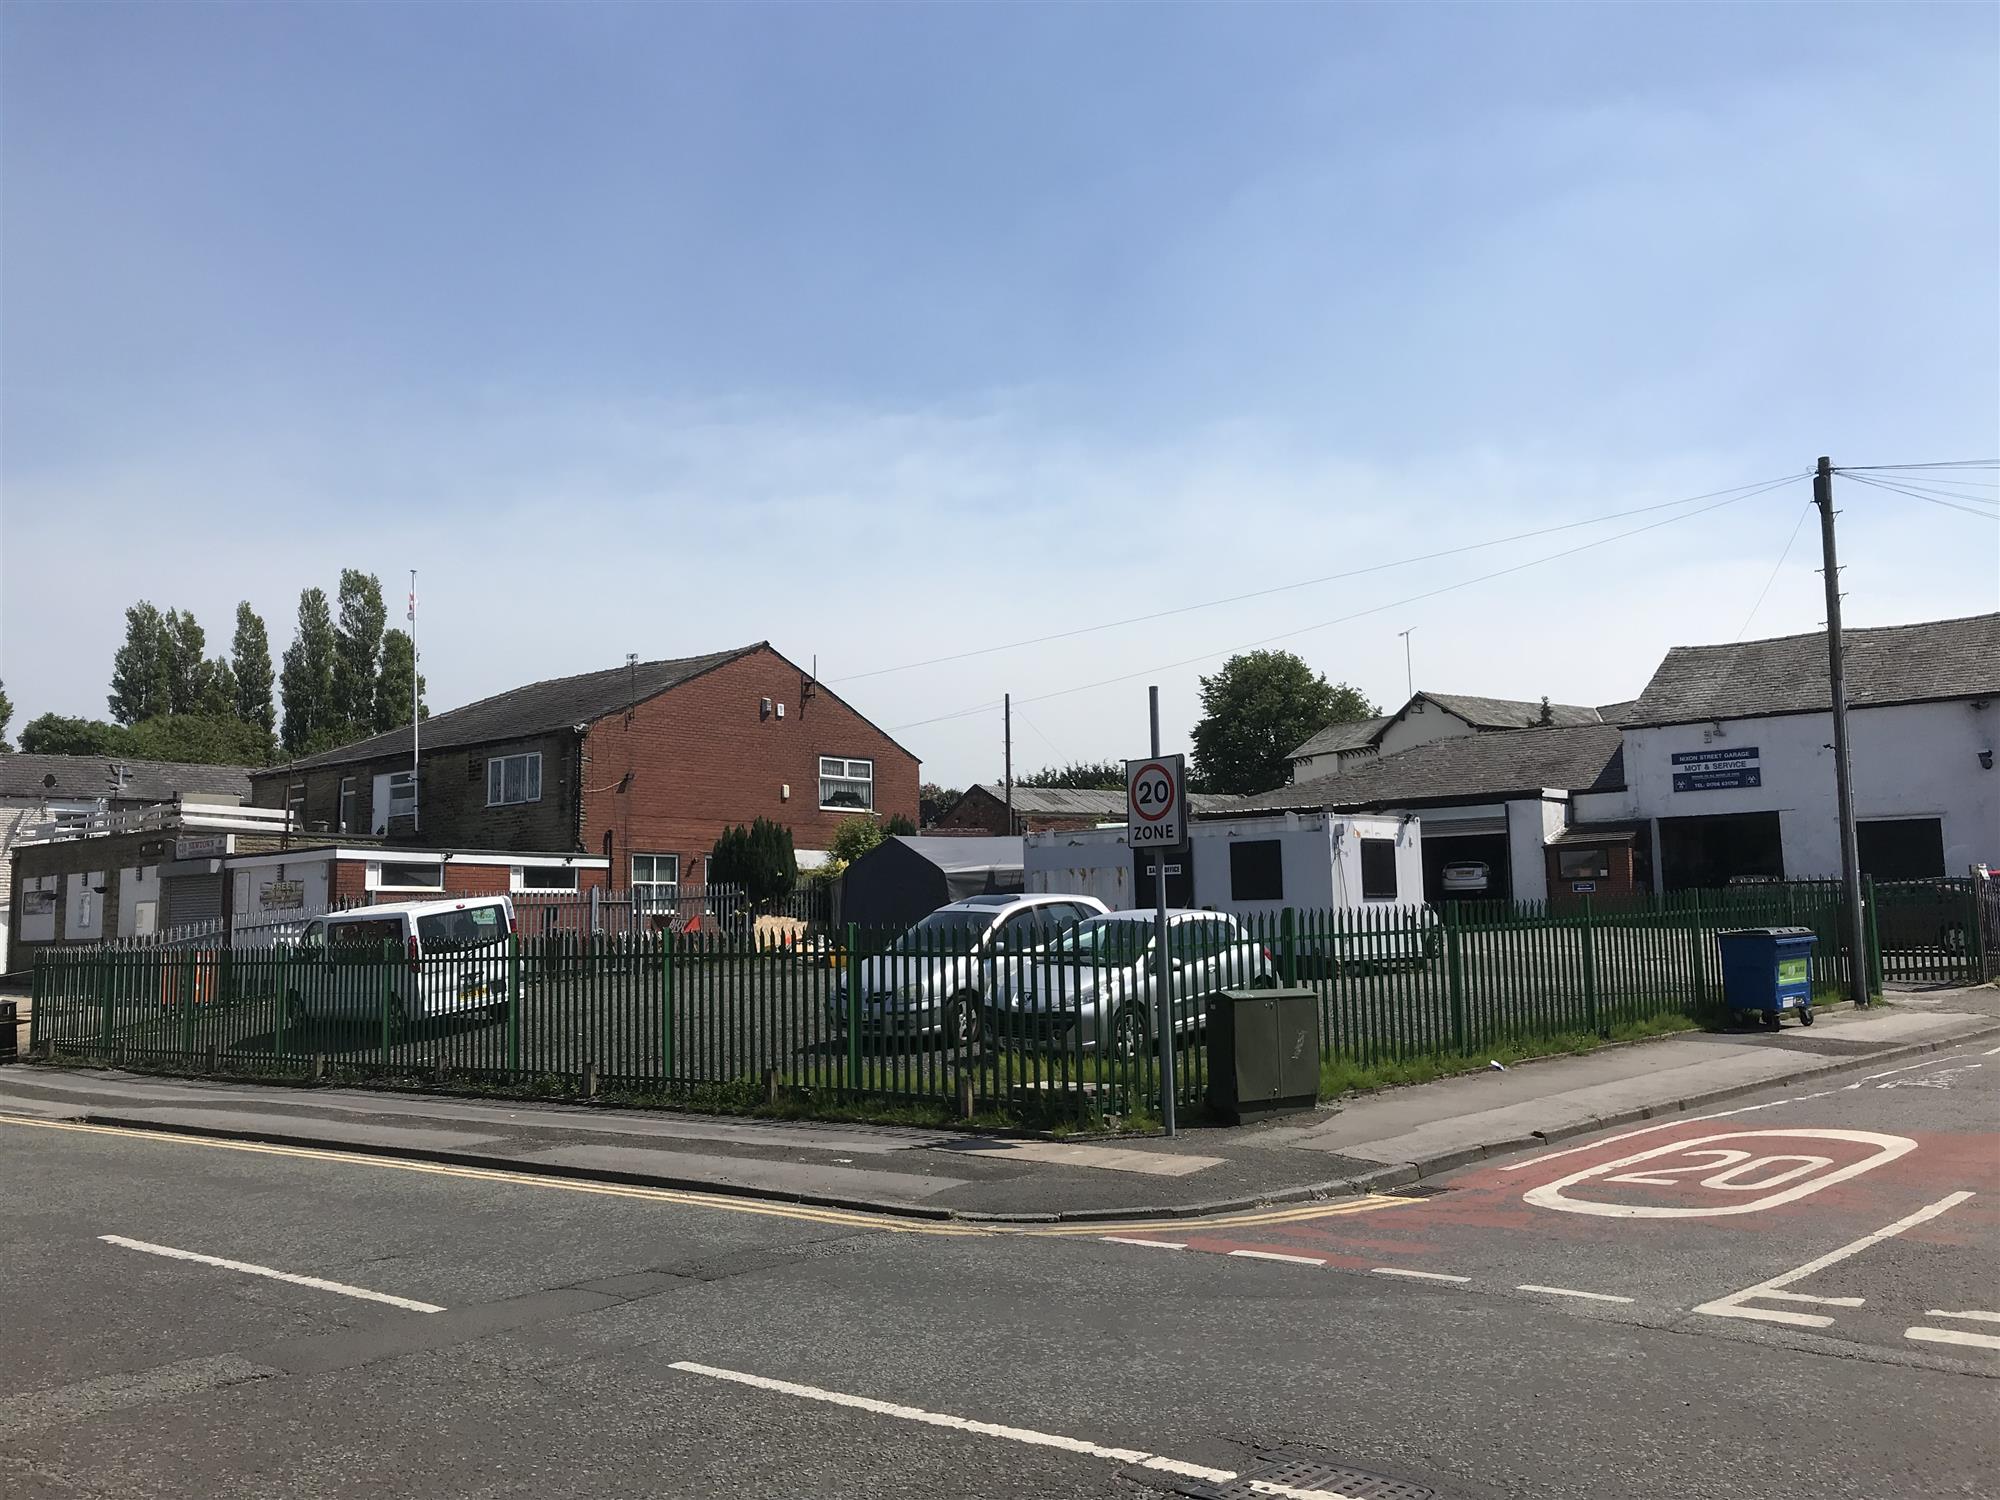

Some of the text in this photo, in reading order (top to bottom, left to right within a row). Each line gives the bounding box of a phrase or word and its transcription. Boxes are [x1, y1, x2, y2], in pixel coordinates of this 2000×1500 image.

[1684, 764, 1702, 772] MOT
[1712, 760, 1747, 770] SERVICE
[1138, 780, 1169, 804] 20
[1134, 824, 1174, 840] ZONE
[1602, 1149, 1835, 1190] 20
